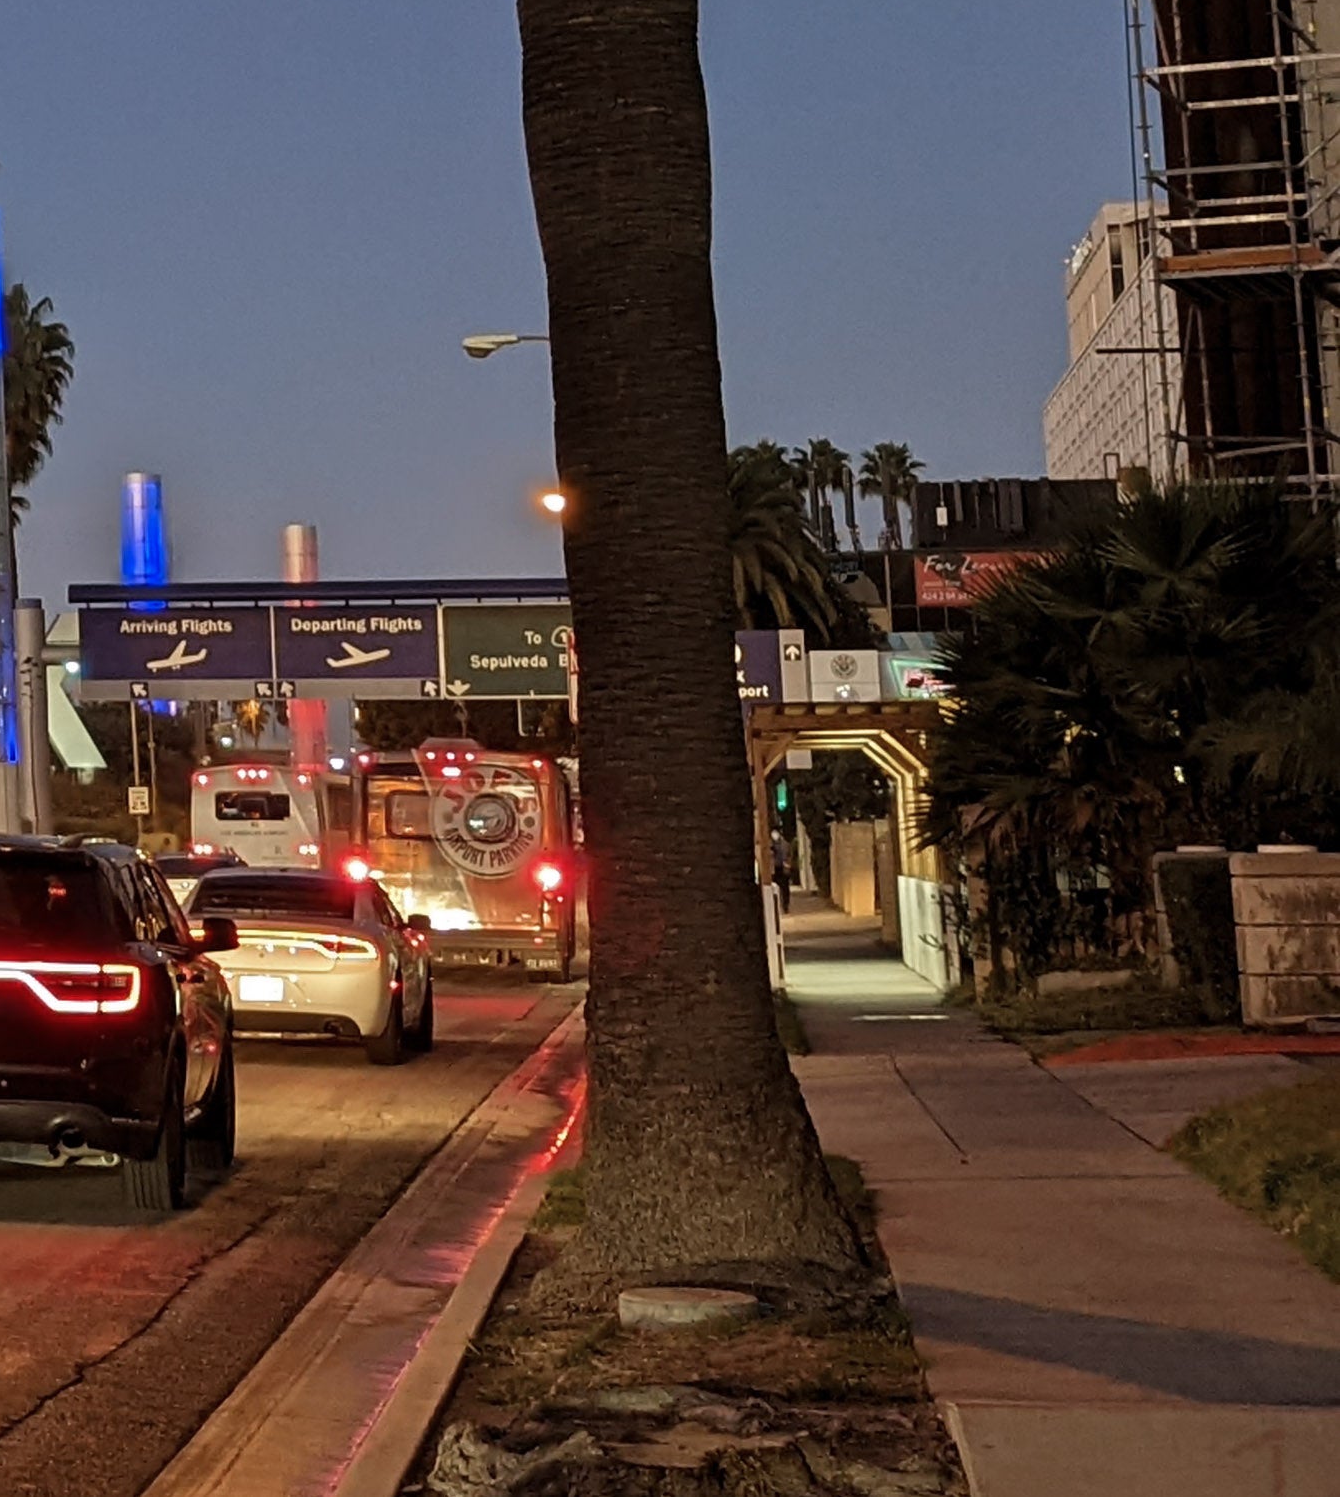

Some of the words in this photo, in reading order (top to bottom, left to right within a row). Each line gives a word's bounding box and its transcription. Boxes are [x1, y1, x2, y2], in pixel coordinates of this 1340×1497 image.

[923, 554, 957, 573] For
[120, 619, 178, 635] Arriving
[181, 618, 233, 635] Flights
[291, 617, 367, 633] Departing
[370, 616, 422, 633] Flights
[524, 630, 542, 645] To
[470, 654, 548, 670] Sepulveda
[444, 827, 487, 868] AIRPORT
[489, 829, 535, 869] PARKING
